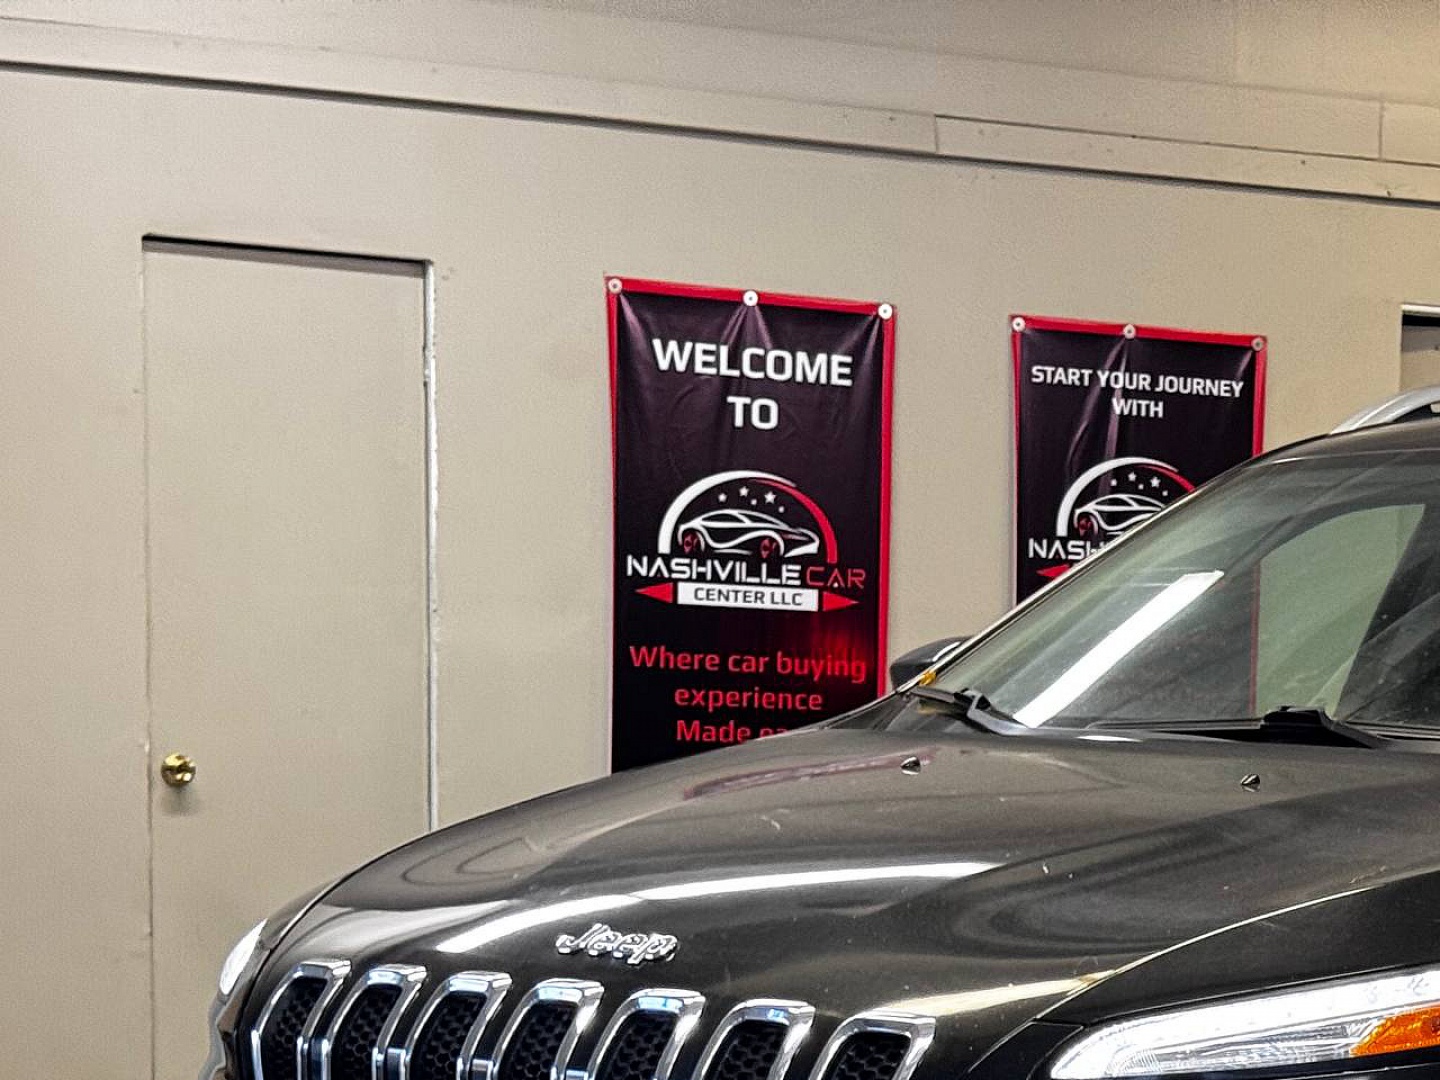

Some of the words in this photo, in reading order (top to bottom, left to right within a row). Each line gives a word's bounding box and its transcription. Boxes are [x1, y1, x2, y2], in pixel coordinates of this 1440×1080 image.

[652, 338, 854, 387] WELCOME
[1031, 365, 1093, 387] START
[1096, 370, 1152, 392] YOUR
[1154, 375, 1244, 398] JOURNEY
[726, 396, 779, 430] TO
[1111, 397, 1164, 418] WITH
[693, 587, 766, 605] CENTER
[770, 591, 803, 606] LLC
[629, 645, 721, 671] Where
[727, 652, 770, 674] car
[775, 650, 868, 683] buying
[674, 686, 824, 713] experience
[676, 720, 751, 744] Made
[555, 923, 679, 965] Jeep
